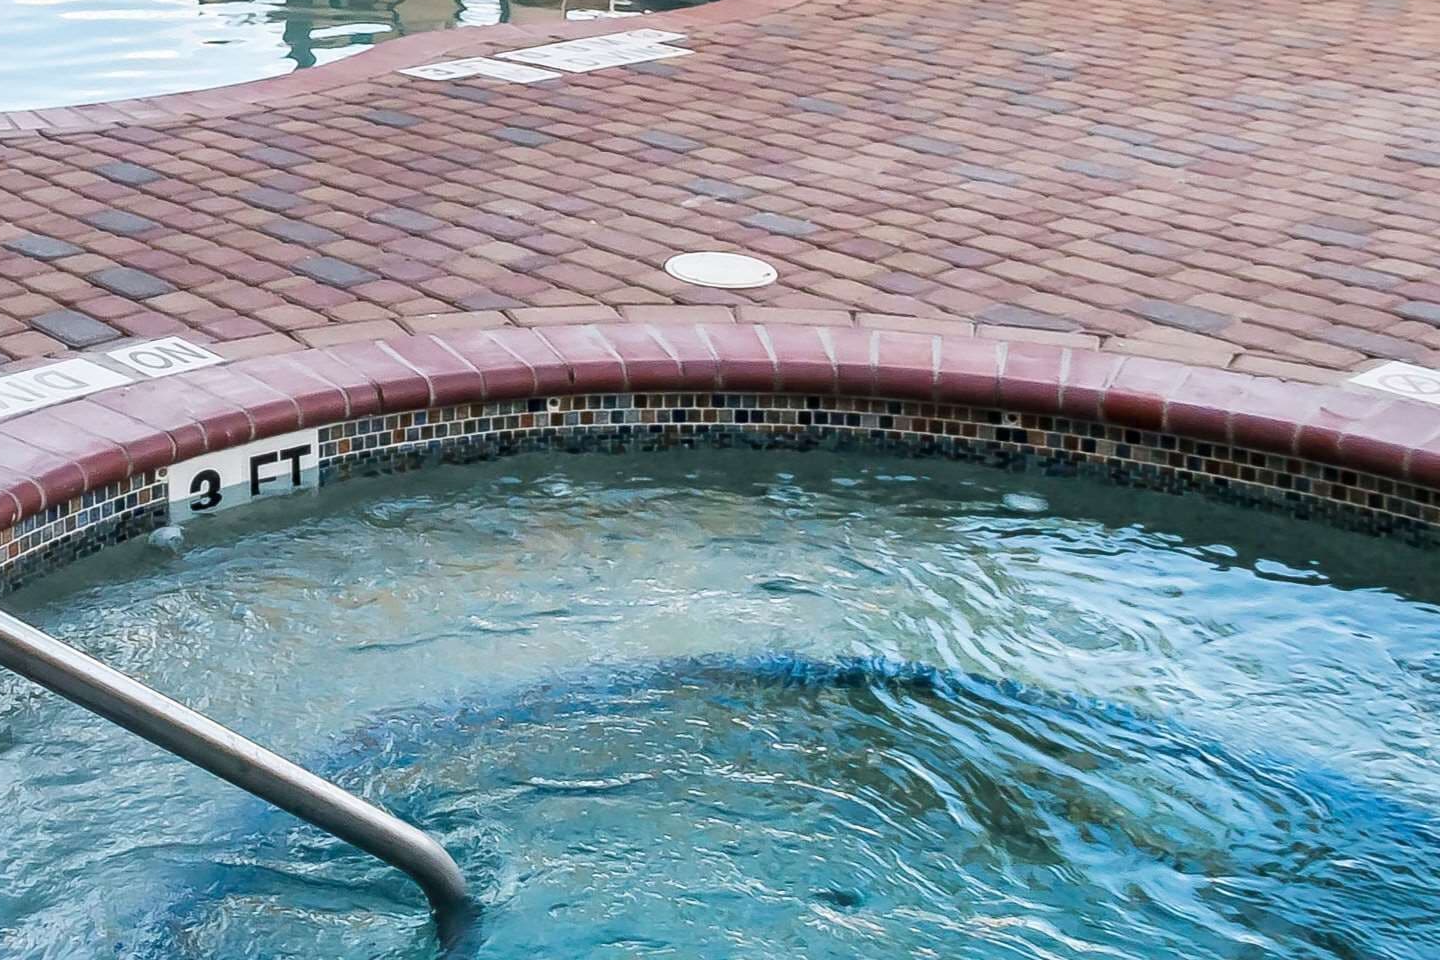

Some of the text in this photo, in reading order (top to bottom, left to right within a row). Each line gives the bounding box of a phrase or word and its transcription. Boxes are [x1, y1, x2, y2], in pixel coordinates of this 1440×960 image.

[129, 342, 208, 369] NO
[190, 444, 311, 512] 3 FT
